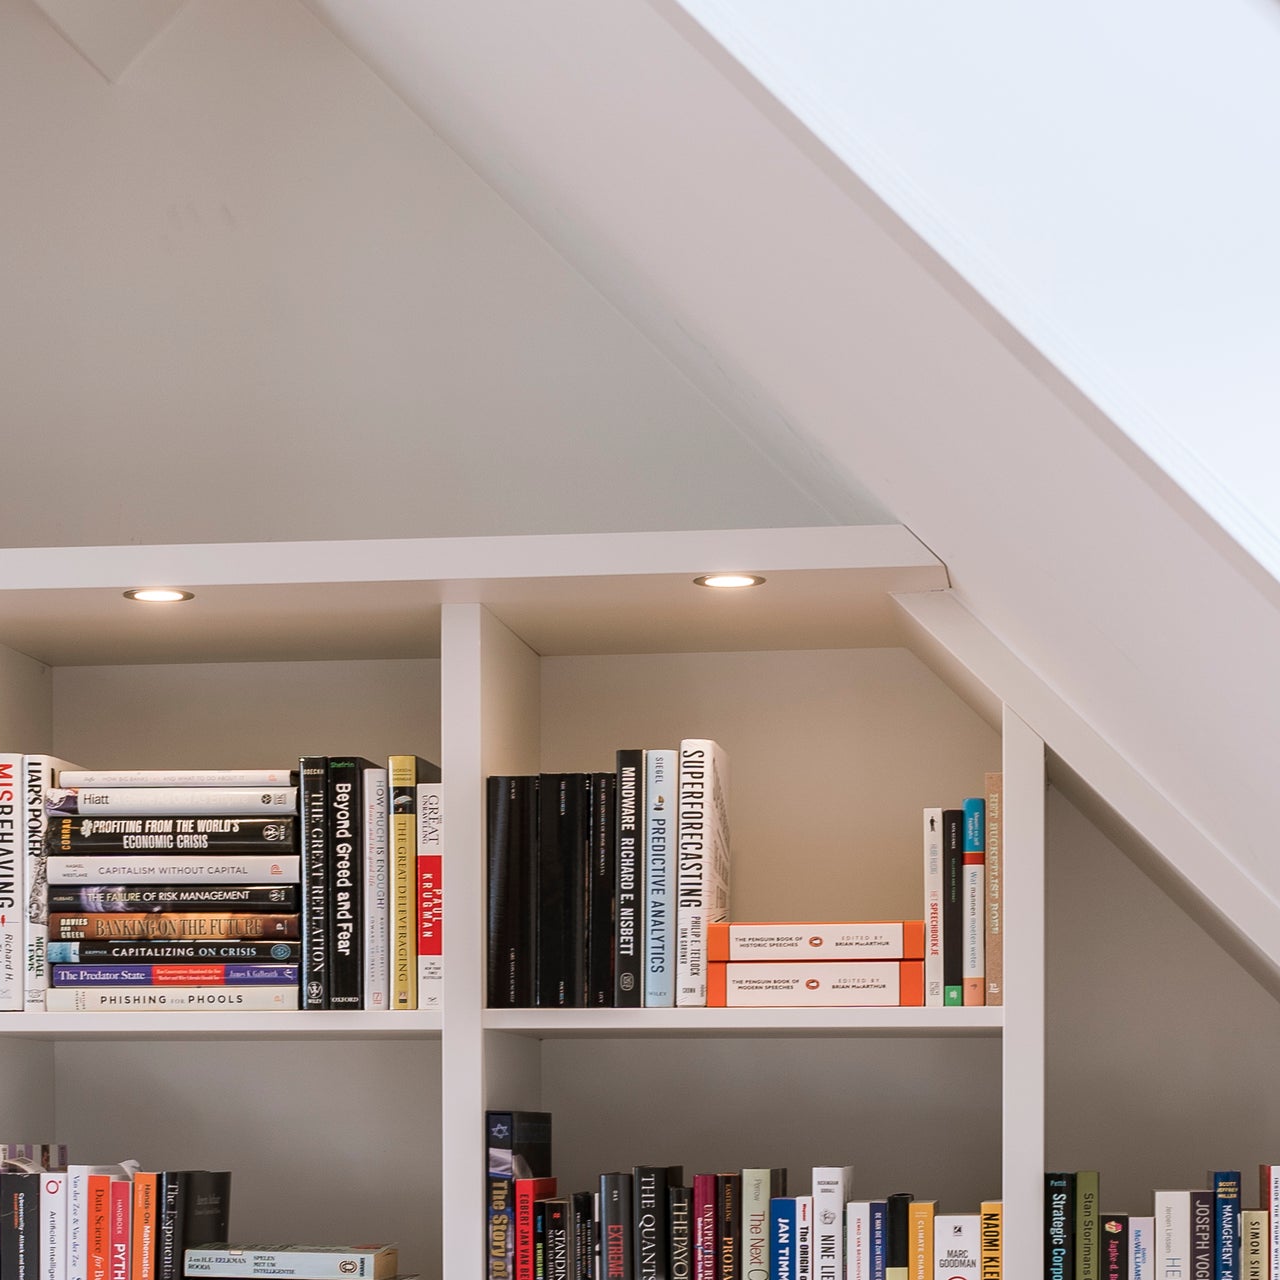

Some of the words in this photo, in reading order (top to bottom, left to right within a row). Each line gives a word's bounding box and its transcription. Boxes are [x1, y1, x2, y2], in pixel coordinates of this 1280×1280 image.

[655, 758, 664, 783] SIEGEL
[333, 783, 352, 838] Beyond
[621, 767, 635, 831] MINDWARE
[93, 820, 142, 833] PROFITING
[145, 820, 172, 833] FROM
[177, 820, 194, 832] THE
[198, 820, 240, 832] WORLD'S
[124, 835, 173, 849] ECONOMIC
[177, 835, 208, 848] CRISIS
[680, 750, 705, 908] SUPERFORECASTING
[336, 843, 352, 887] Greed
[620, 838, 634, 890] RICHARD
[651, 818, 665, 895] PREDICTIVE
[336, 892, 352, 919] and
[422, 874, 432, 938] KRUGMAN
[620, 894, 634, 904] E.
[337, 923, 353, 956] Fear
[620, 908, 633, 956] NISBETT
[651, 900, 665, 973] ANALYTICS
[690, 917, 701, 938] PHILIP
[5, 933, 13, 969] Richard
[690, 949, 700, 976] TETLOCK
[5, 972, 13, 982] H.
[641, 1174, 655, 1208] THE
[750, 1211, 764, 1234] The
[778, 1218, 789, 1243] JAN
[984, 1213, 999, 1251] NAOMI
[1051, 1194, 1066, 1244] Strategic
[1195, 1200, 1208, 1250] JOSEPH
[142, 1226, 150, 1278] Mathematics
[608, 1225, 623, 1277] EXTREME
[750, 1238, 764, 1265] Next
[821, 1235, 834, 1259] NINE
[939, 1259, 976, 1267] GOODMAN
[947, 1250, 968, 1258] MARC
